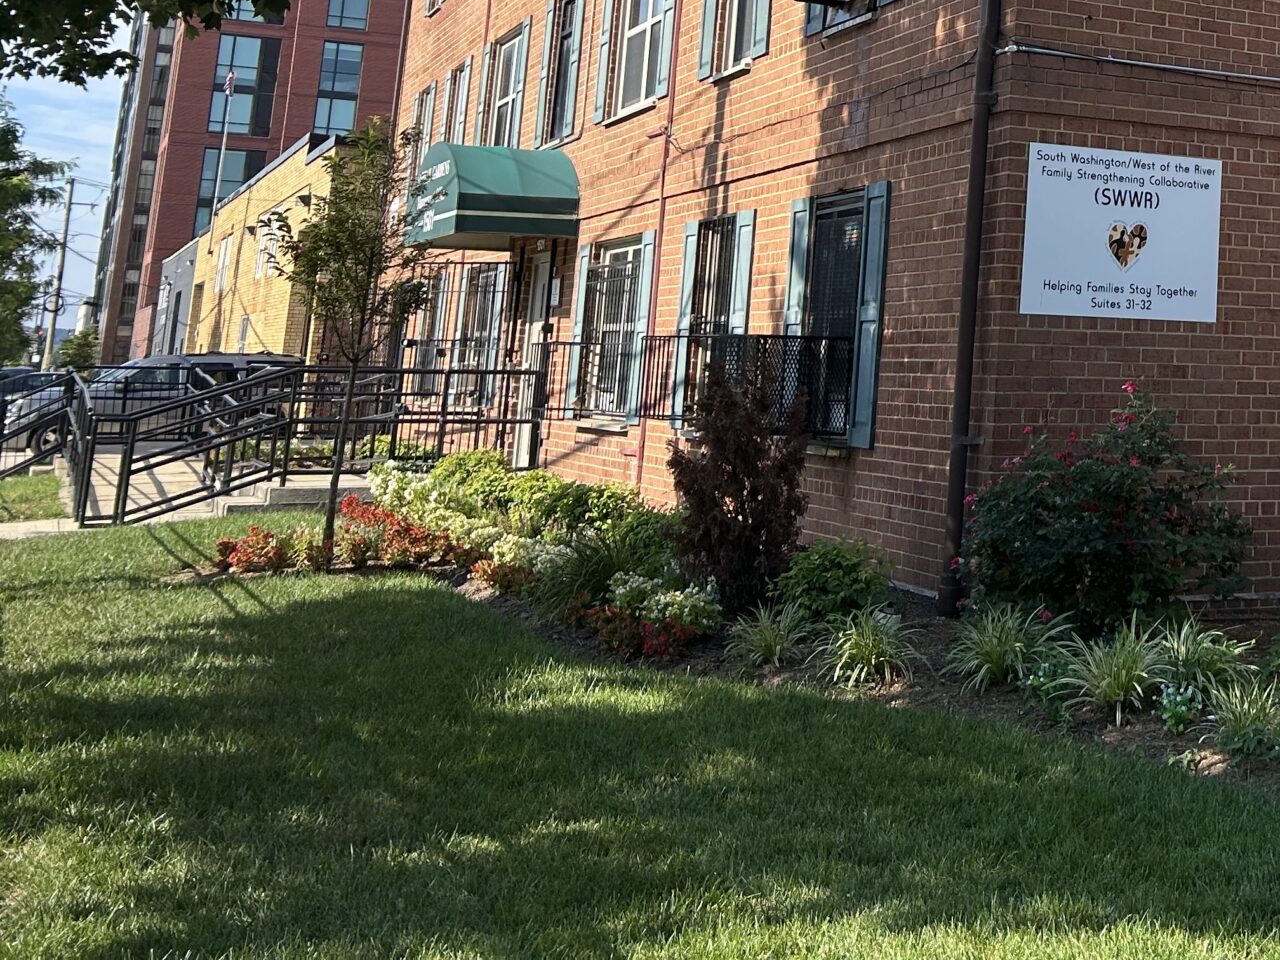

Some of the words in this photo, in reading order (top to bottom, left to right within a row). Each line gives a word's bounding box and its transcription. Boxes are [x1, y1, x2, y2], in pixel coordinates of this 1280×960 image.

[1036, 150, 1066, 163] South
[1071, 153, 1156, 171] Washington/West
[1160, 161, 1171, 172] of
[1175, 162, 1190, 174] the
[1194, 163, 1216, 176] River
[1041, 166, 1072, 181] Family
[1077, 169, 1145, 187] Strengthening
[1149, 176, 1210, 190] Collaborative
[1094, 188, 1160, 209] (SWWR)
[1043, 280, 1082, 295] Helping
[1087, 282, 1124, 294] Families
[1129, 283, 1151, 297] Stay
[1156, 285, 1198, 299] Together
[1091, 298, 1121, 310] Suites
[1125, 299, 1152, 310] 31-32
